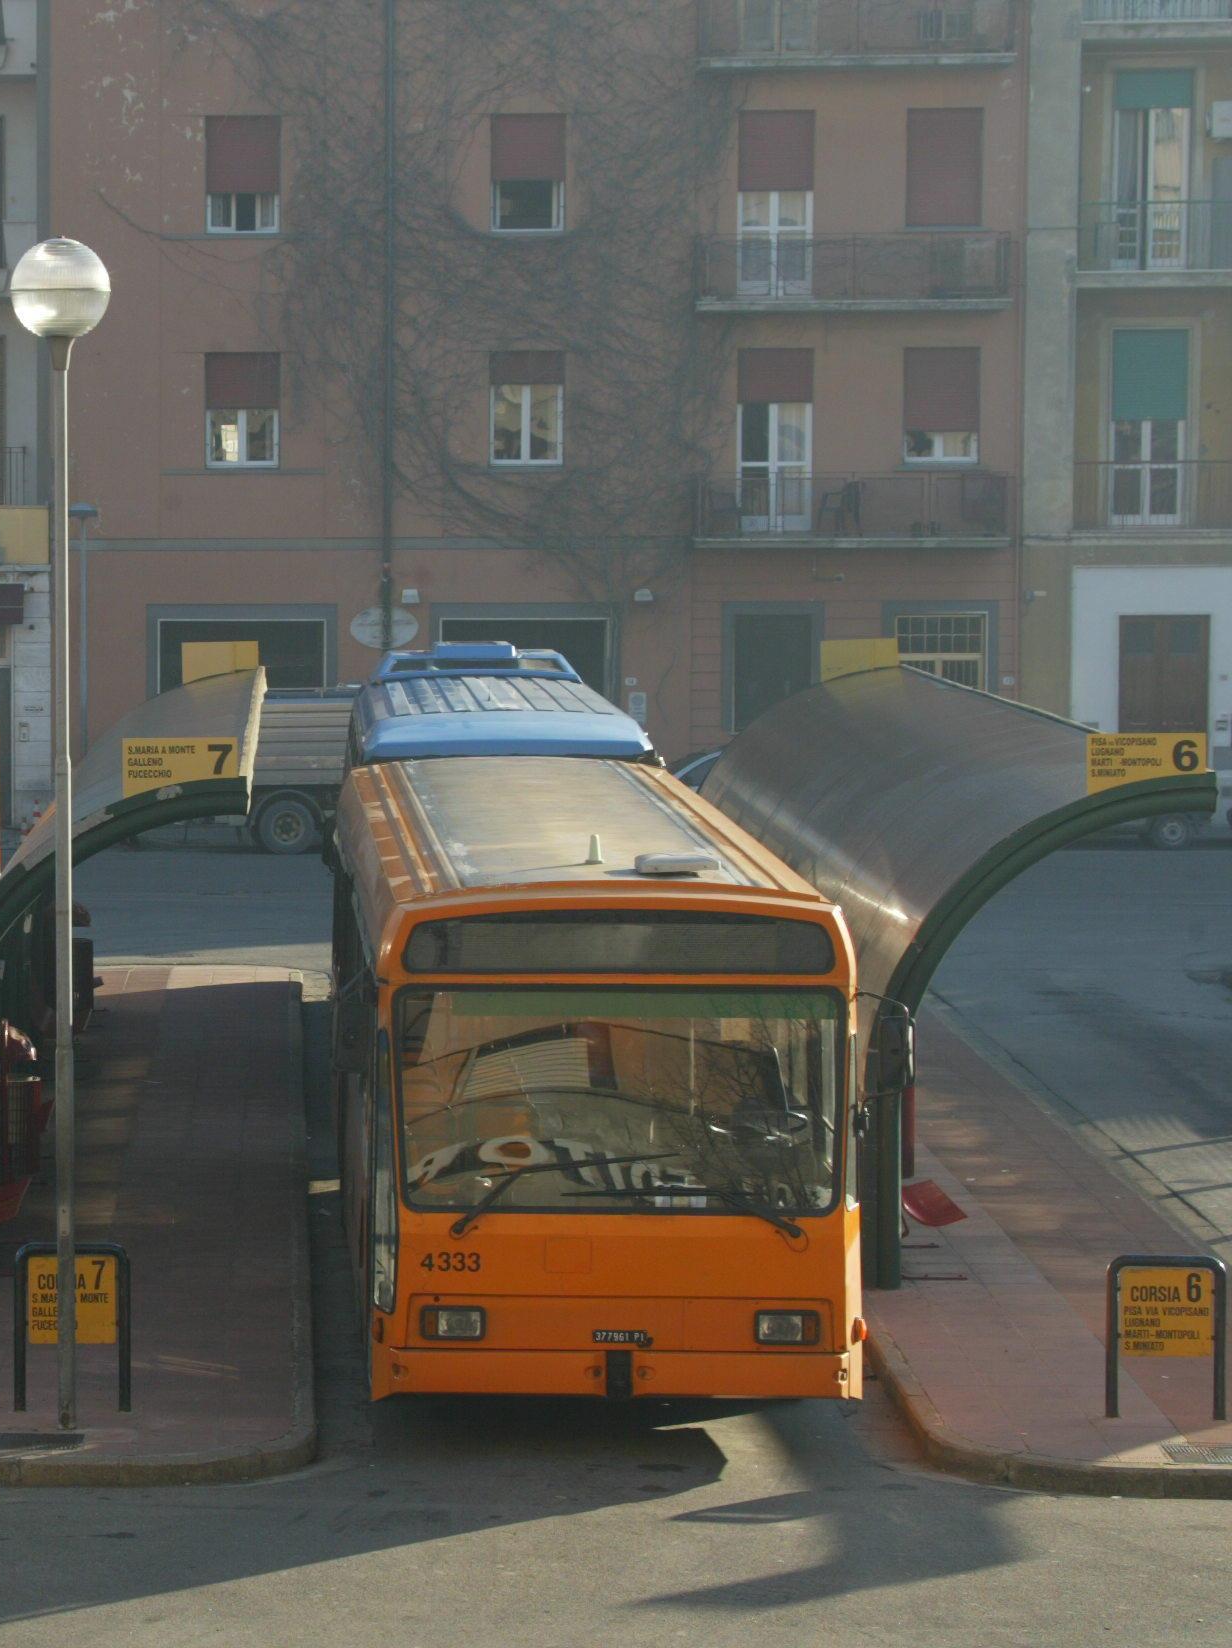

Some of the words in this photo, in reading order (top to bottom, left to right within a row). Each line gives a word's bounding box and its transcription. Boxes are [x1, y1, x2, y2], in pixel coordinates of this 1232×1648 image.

[1114, 738, 1157, 746] VICOPISANO
[128, 745, 158, 754] S.MARIA
[162, 746, 167, 754] A
[169, 746, 195, 754] MONTE
[208, 744, 232, 775] 7
[1172, 739, 1199, 772] 6
[128, 758, 163, 766] GALLENO
[128, 770, 172, 778] FUCECCHIO
[420, 1252, 481, 1272] 4333
[92, 1260, 105, 1290] 7
[1130, 1286, 1181, 1302] CORSIA
[1186, 1272, 1201, 1302] 6
[80, 1293, 109, 1303] MONTE
[1124, 1306, 1142, 1315] PISA
[1145, 1306, 1158, 1315] VIA
[1162, 1306, 1209, 1316] VICOPISANO
[595, 1332, 629, 1341] 377961
[634, 1332, 645, 1341] PI
